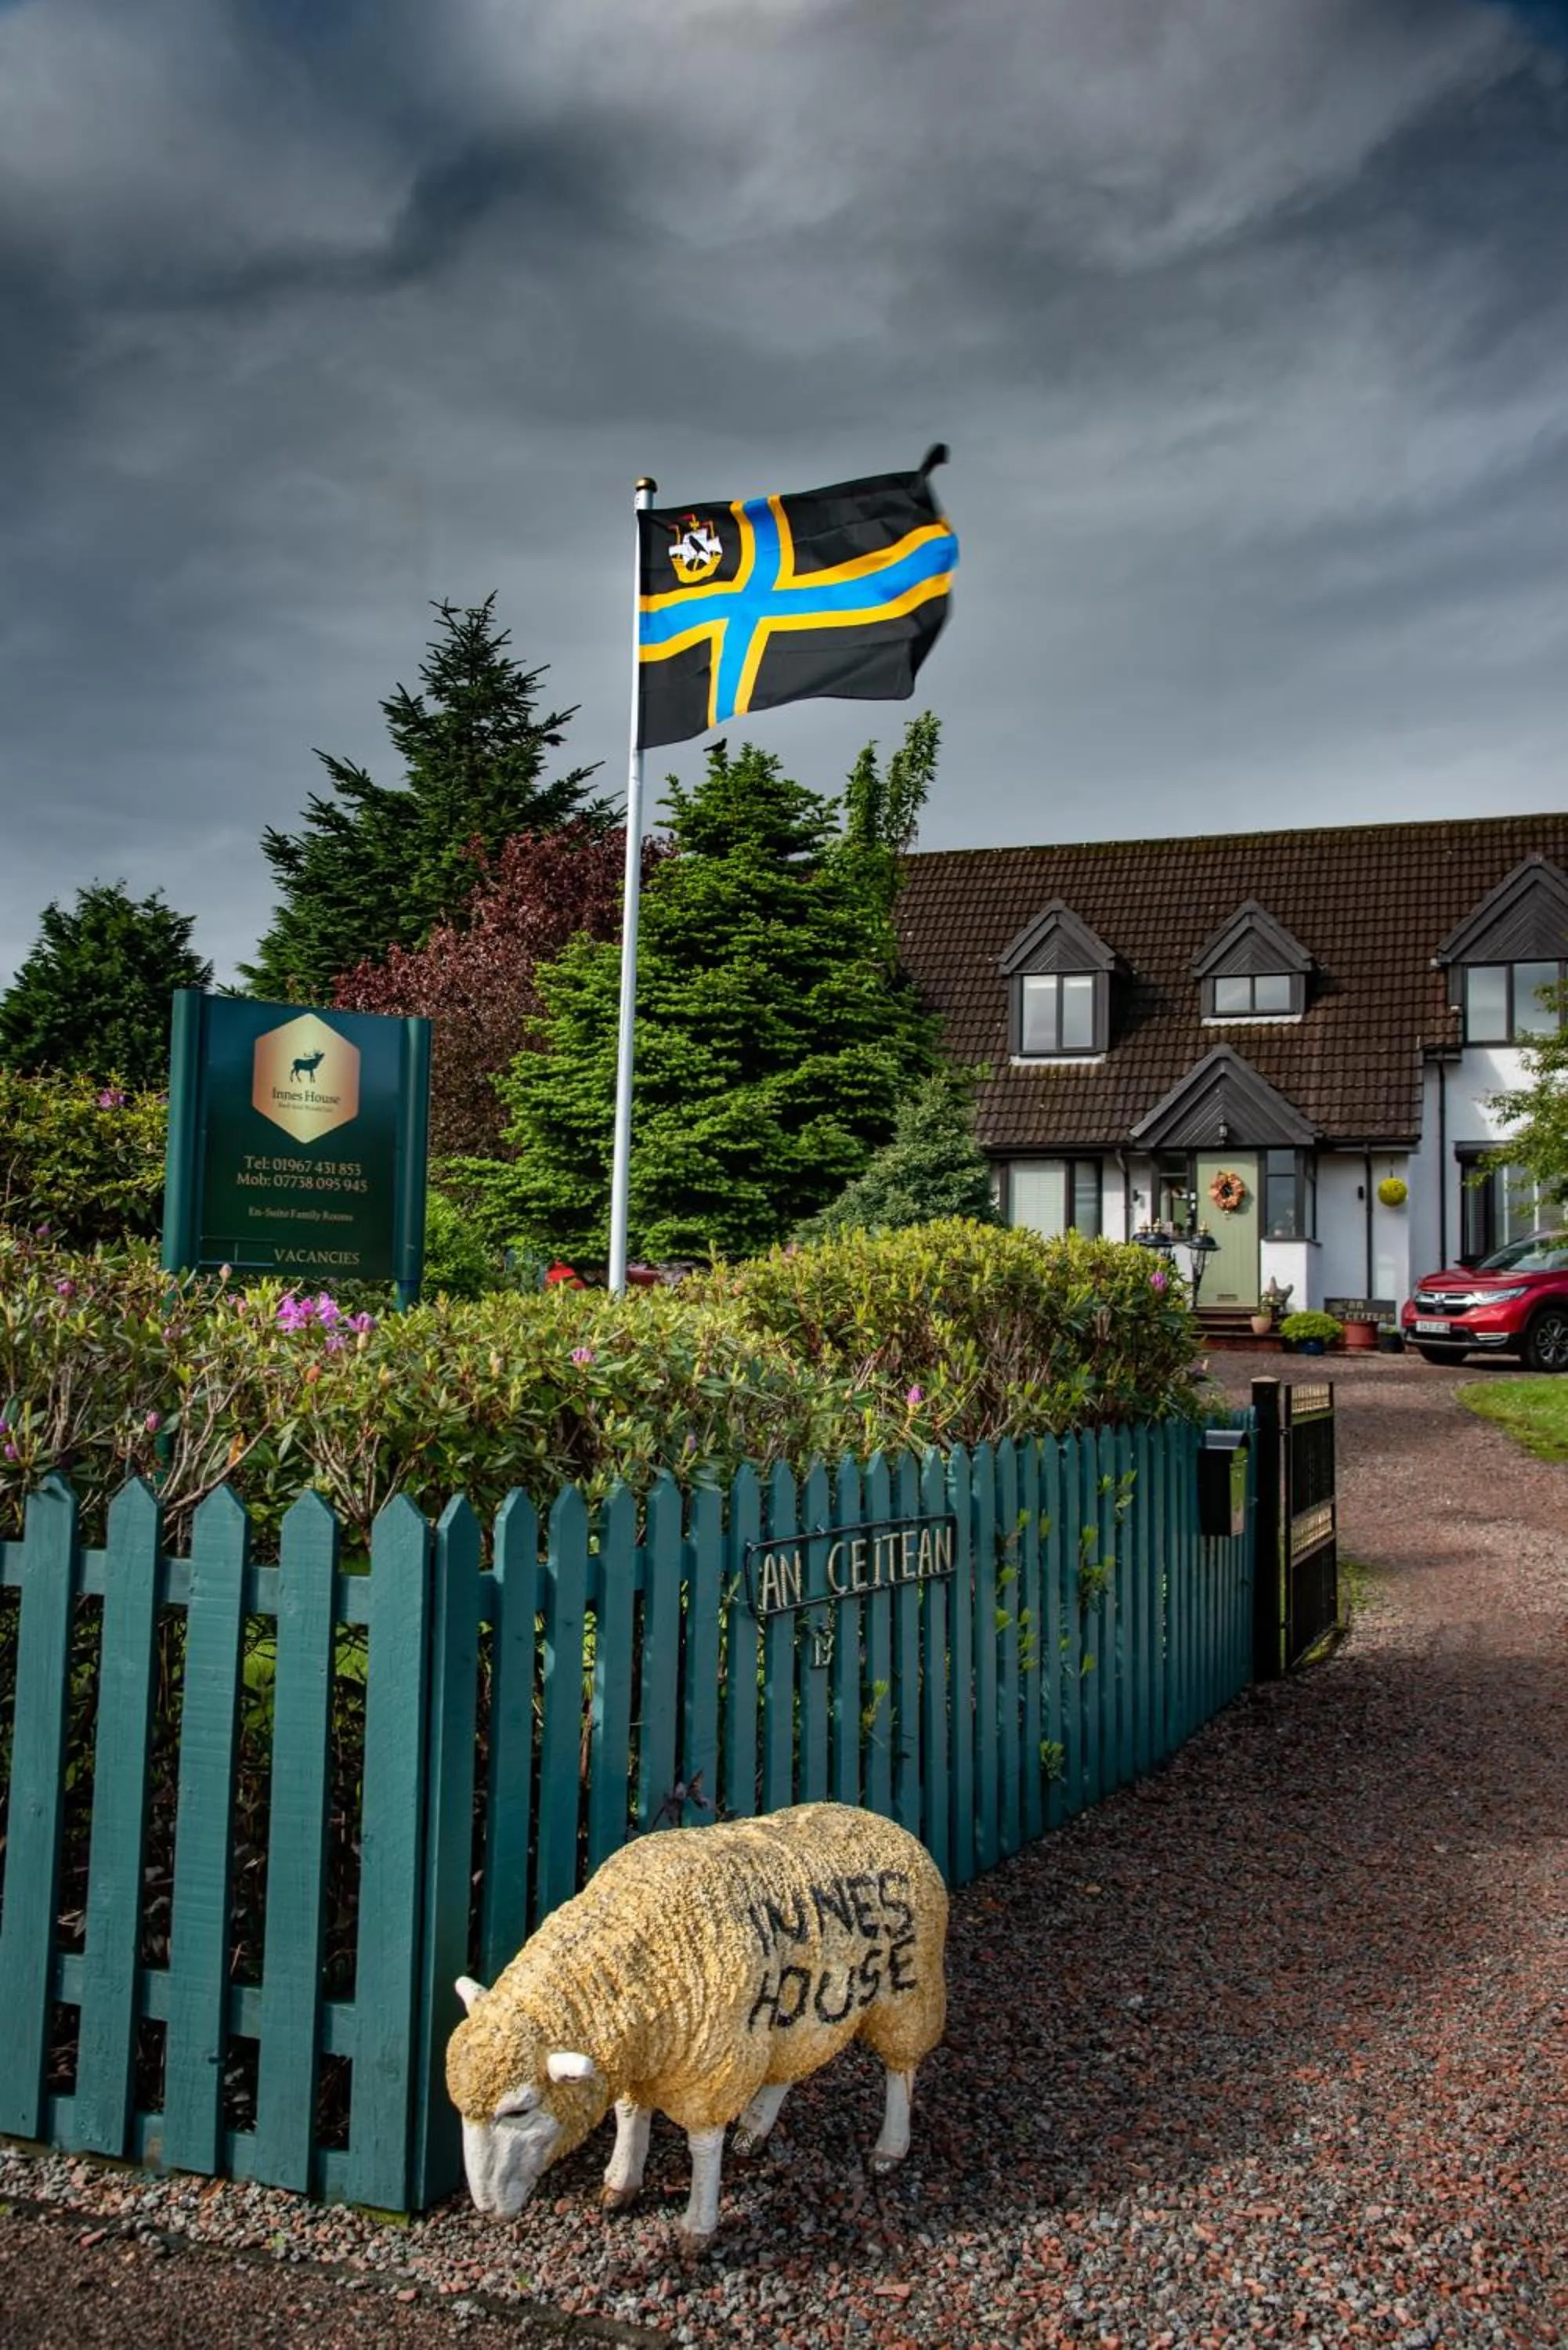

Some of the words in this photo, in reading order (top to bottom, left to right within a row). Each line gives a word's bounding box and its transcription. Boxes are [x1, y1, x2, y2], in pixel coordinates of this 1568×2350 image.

[273, 1086, 303, 1101] Innes
[305, 1090, 341, 1105] House
[244, 1155, 270, 1170] Tel:
[273, 1158, 313, 1173] 01967
[274, 1248, 360, 1265] VACANCIES
[762, 1550, 802, 1612] AN
[828, 1526, 952, 1595] CEITEAN
[747, 1934, 917, 2033] HOUSE
